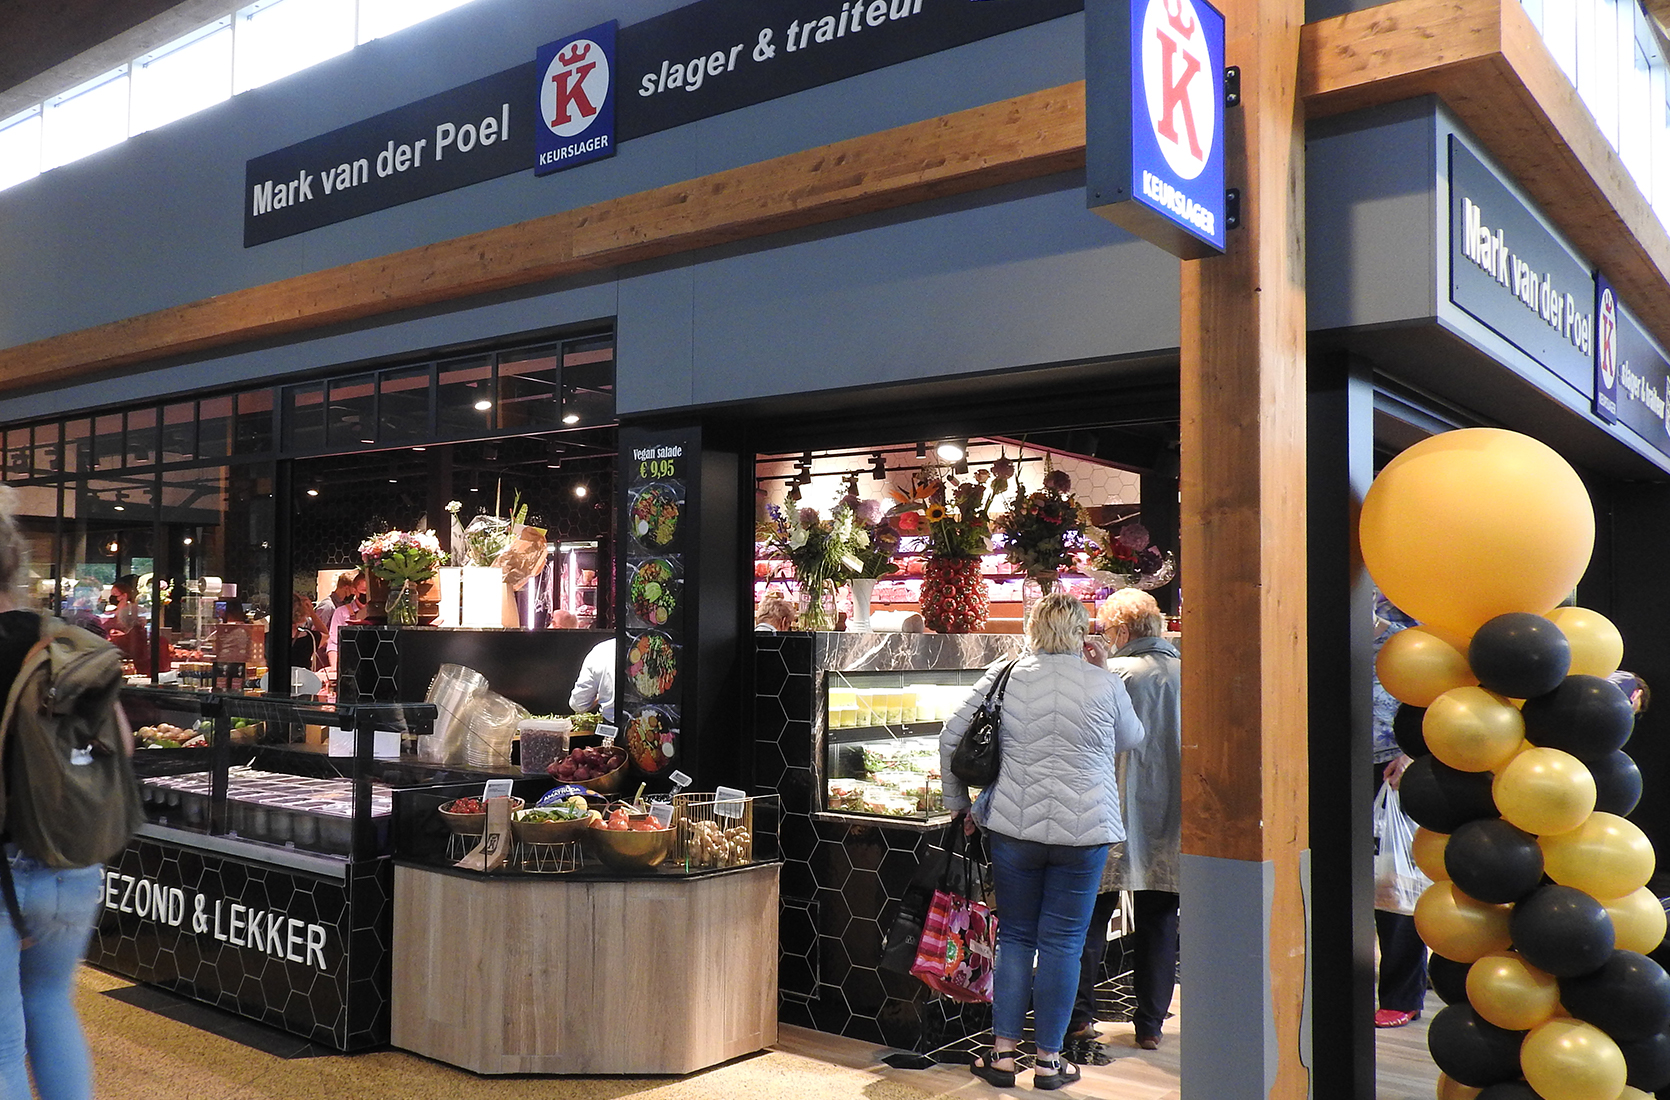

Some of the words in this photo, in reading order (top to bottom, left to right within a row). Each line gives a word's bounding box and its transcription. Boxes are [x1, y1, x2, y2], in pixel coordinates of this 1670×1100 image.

[551, 61, 597, 128] K
[638, 44, 744, 97] slager
[752, 28, 776, 62] &
[1156, 27, 1203, 162] K
[253, 170, 313, 216] Mark
[321, 158, 369, 195] van
[376, 140, 427, 178] der
[436, 103, 510, 161] Poel
[539, 135, 609, 166] KEURSLAGER
[1142, 170, 1215, 236] KEURSLAGER
[1461, 197, 1509, 287] Mark
[1508, 253, 1539, 312] van
[1539, 272, 1564, 331] der
[1563, 293, 1592, 357] Poel
[1602, 313, 1614, 378] K
[633, 448, 656, 461] Vegan
[657, 445, 683, 459] salade
[640, 461, 648, 478] €
[650, 459, 675, 479] 9,95
[192, 893, 208, 934] &
[214, 900, 327, 970] LEKKER
